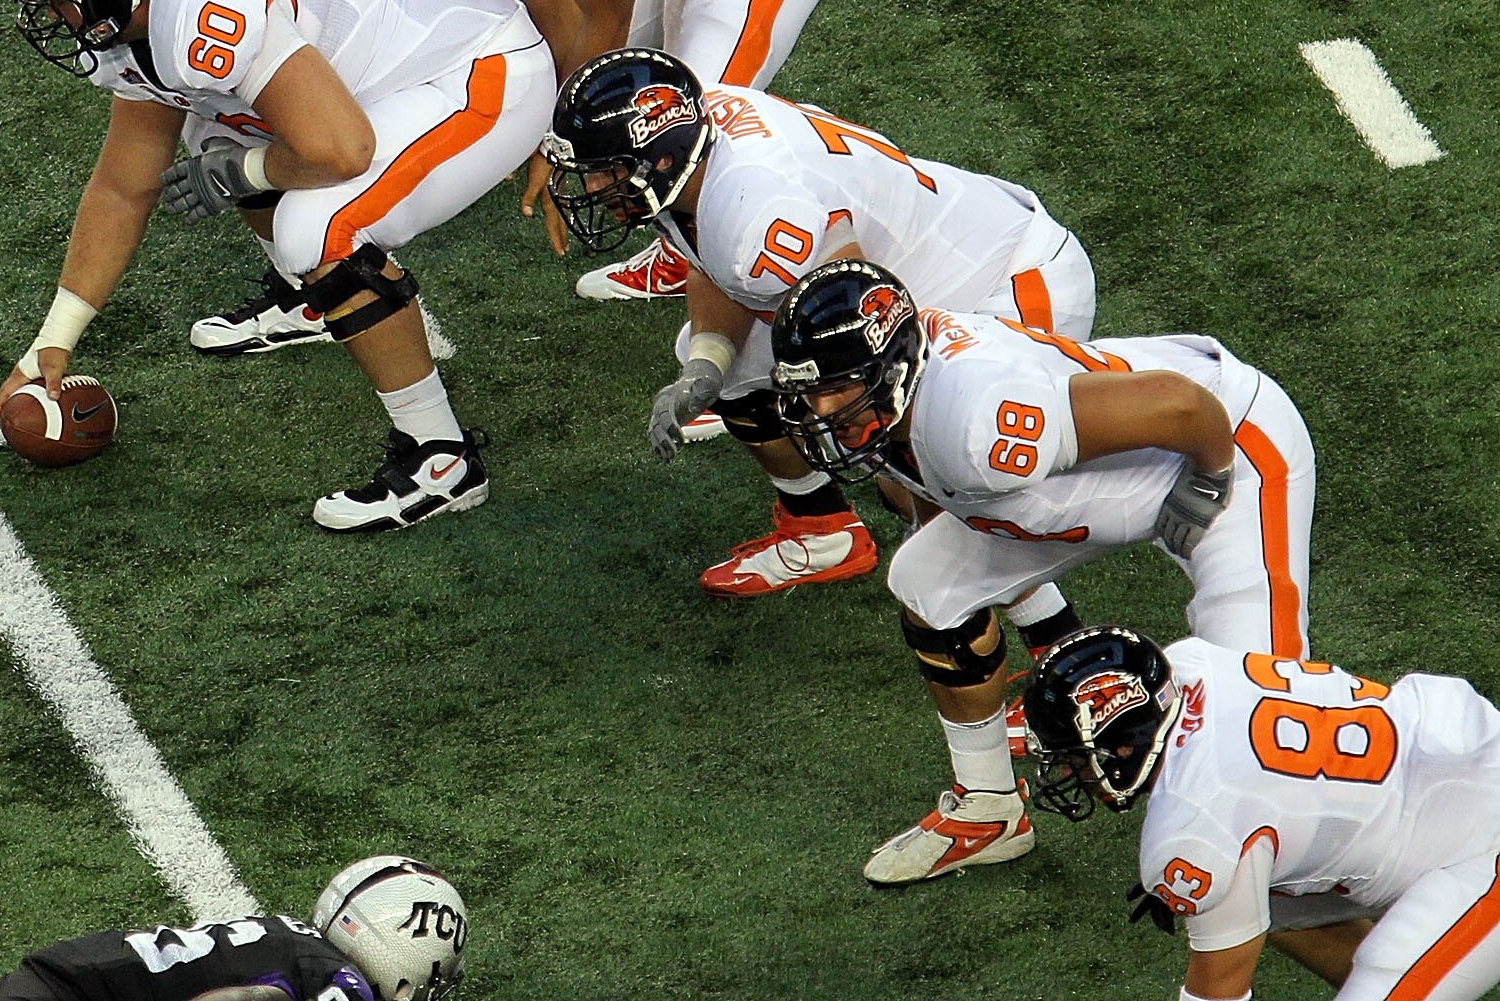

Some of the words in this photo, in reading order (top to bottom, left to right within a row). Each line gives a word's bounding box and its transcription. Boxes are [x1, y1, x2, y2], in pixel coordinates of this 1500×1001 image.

[187, 0, 247, 80] 60
[631, 103, 696, 143] Beavers
[748, 217, 815, 287] 70
[988, 399, 1046, 479] 68
[1076, 685, 1147, 731] eavers
[1242, 650, 1399, 787] 83
[1152, 856, 1213, 918] 83
[397, 901, 467, 956] TCU
